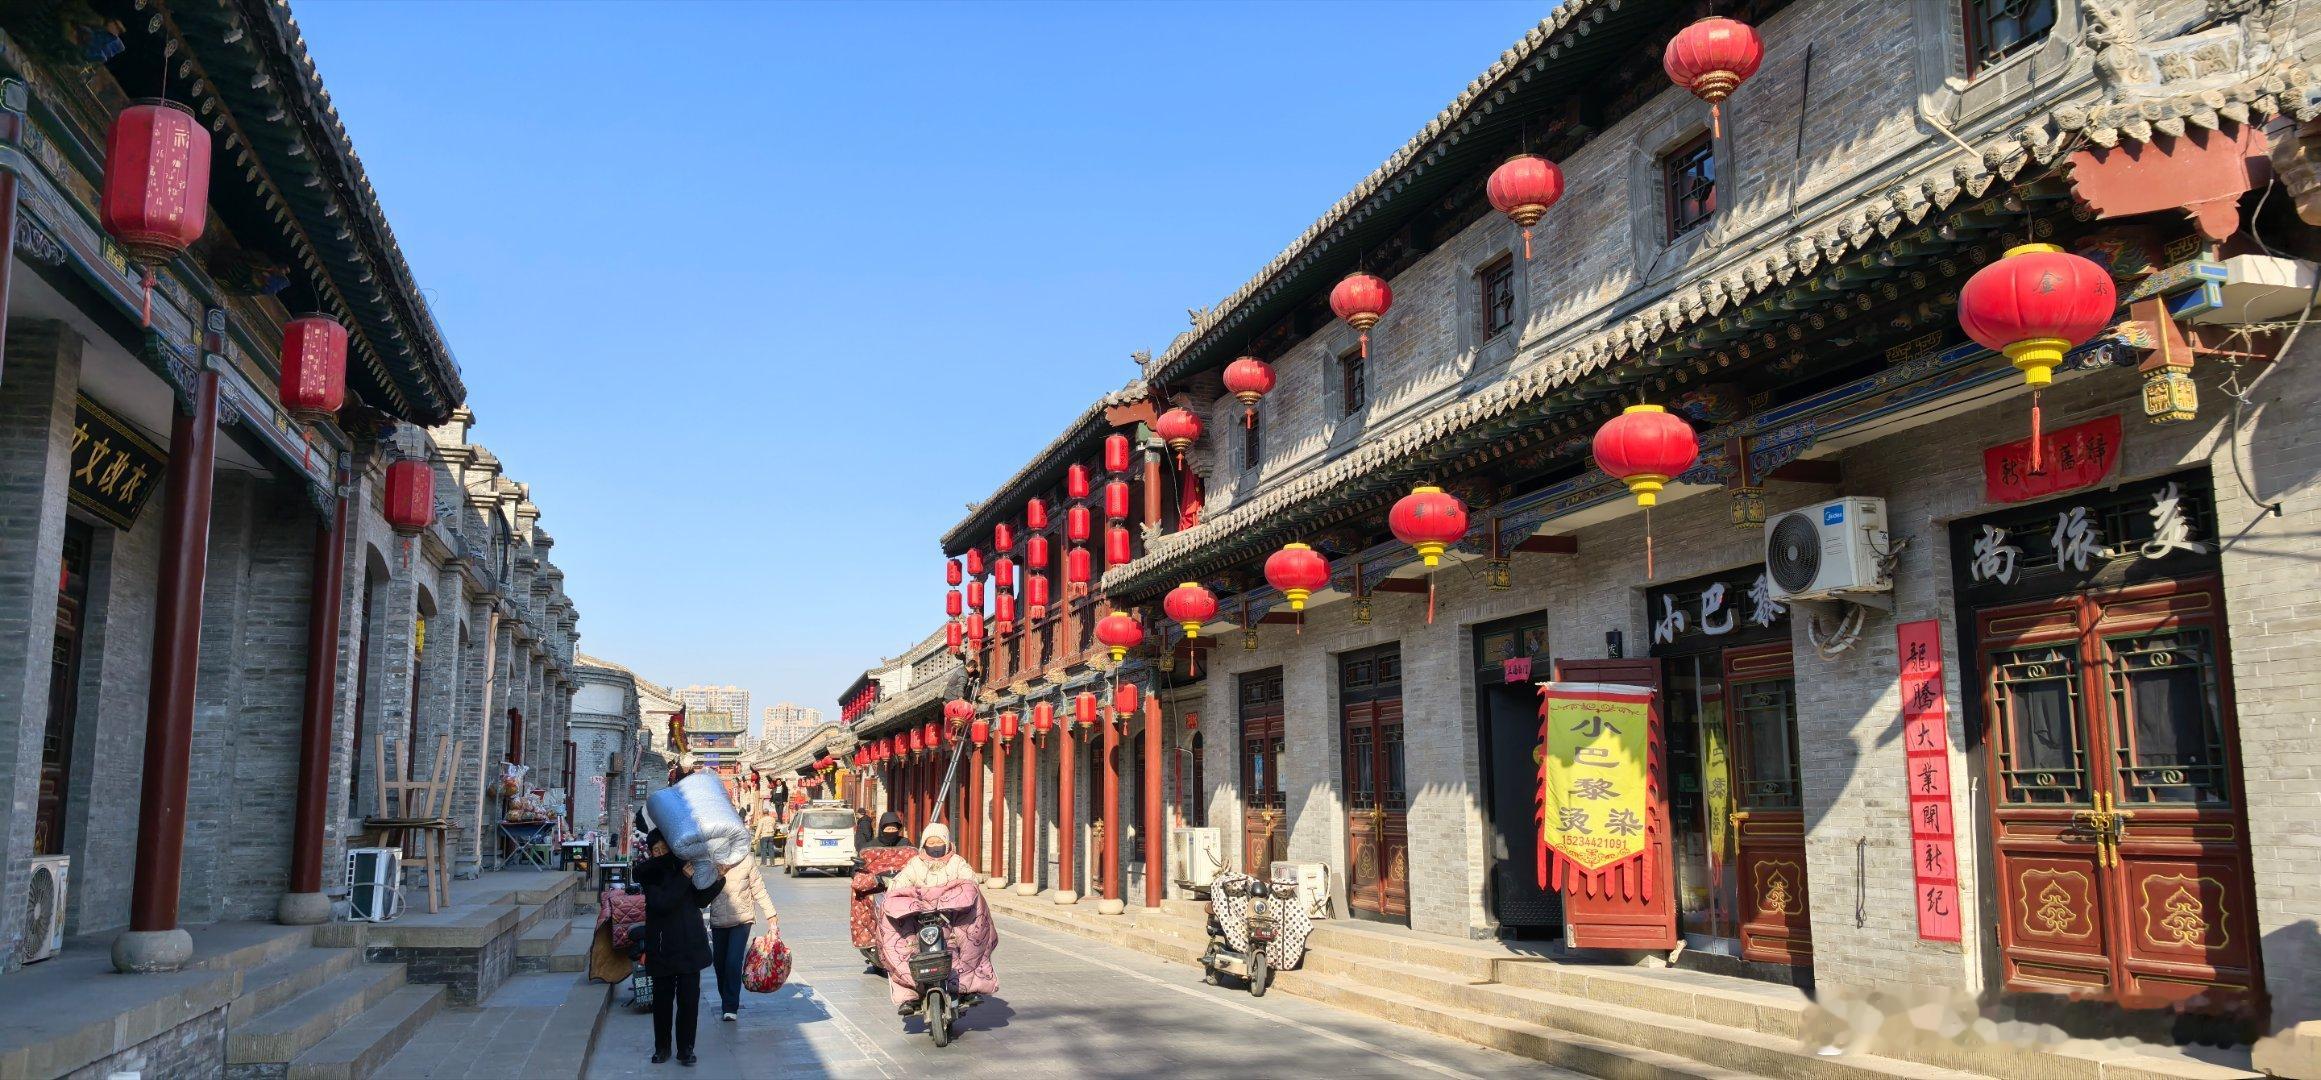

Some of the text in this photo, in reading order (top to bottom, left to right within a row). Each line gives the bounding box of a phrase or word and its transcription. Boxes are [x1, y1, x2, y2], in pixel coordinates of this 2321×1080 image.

[1971, 481, 2207, 585] 尚依美
[1569, 716, 1623, 800] 小巴黎
[1556, 807, 1644, 836] 烫染
[1561, 834, 1628, 849] 15234421091
